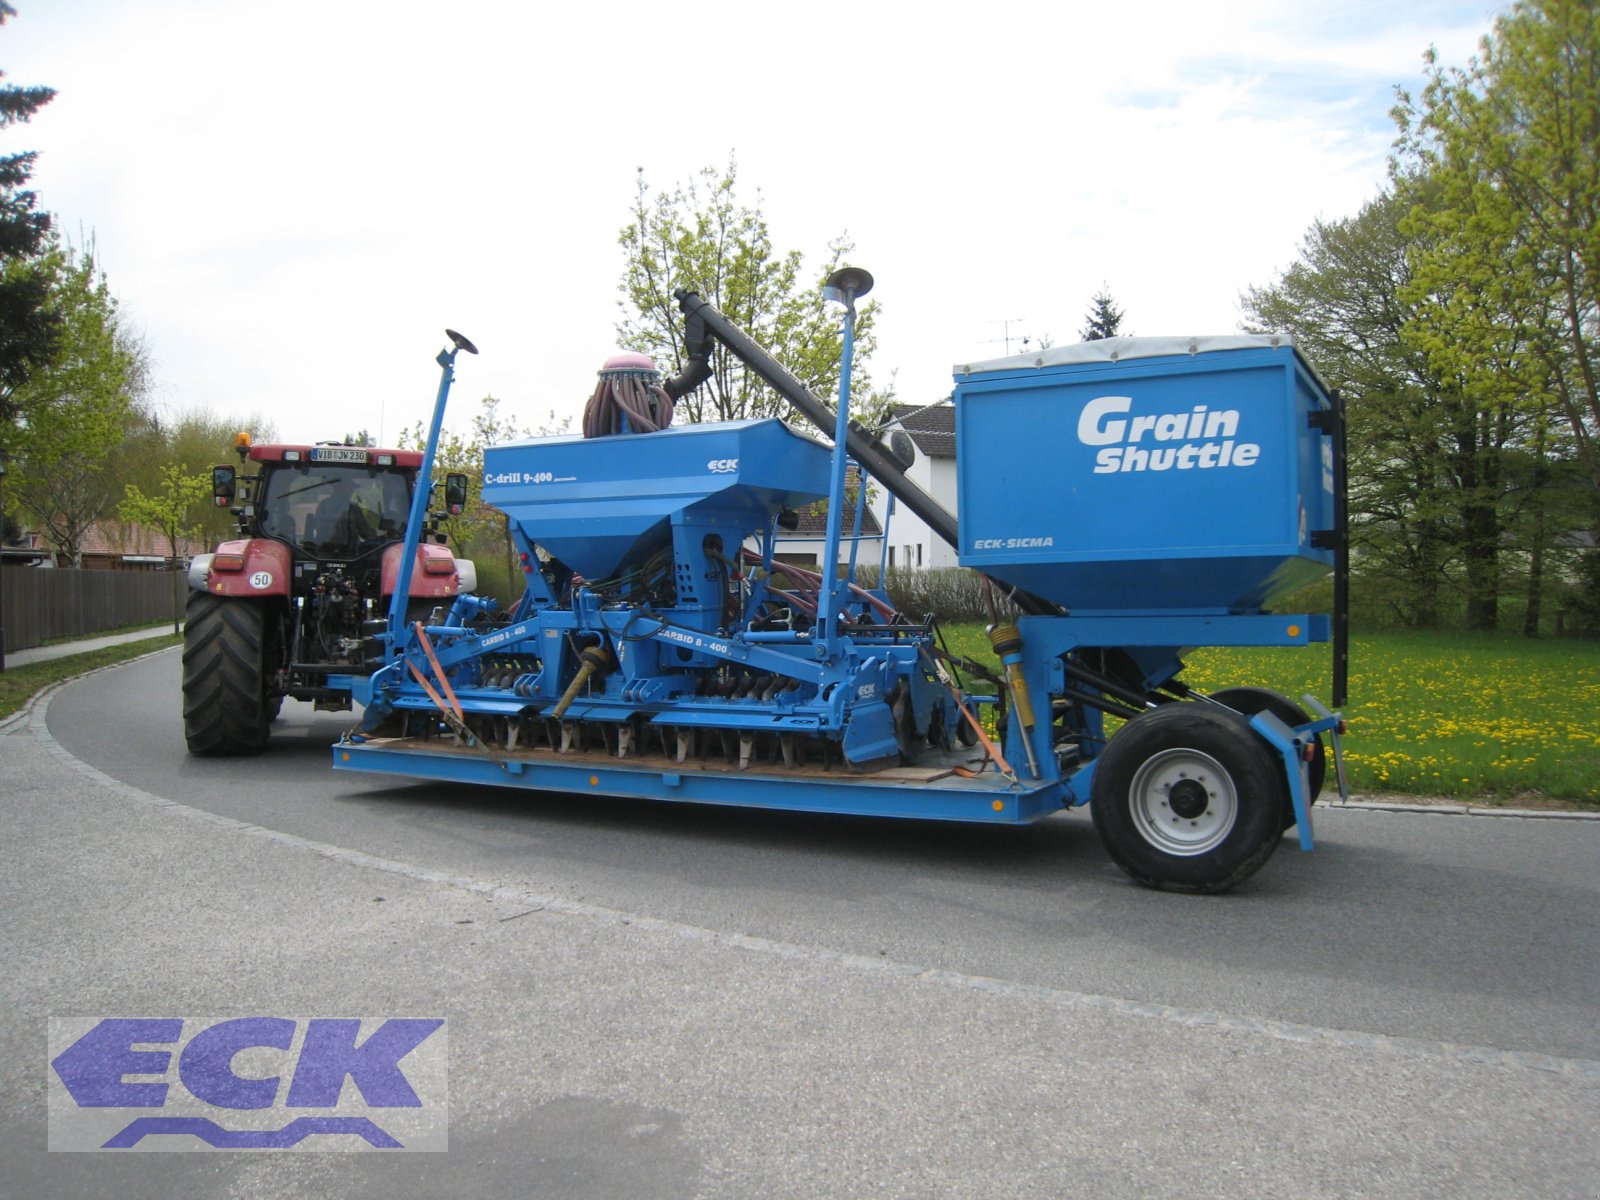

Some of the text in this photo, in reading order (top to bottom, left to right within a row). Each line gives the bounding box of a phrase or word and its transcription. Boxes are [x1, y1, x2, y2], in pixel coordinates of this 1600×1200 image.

[1077, 396, 1239, 446] Grain
[318, 450, 365, 461] VIB JW 230
[707, 458, 739, 470] ECK
[485, 473, 520, 484] C-drill
[523, 472, 552, 484] 9-400
[254, 574, 269, 586] 50
[695, 638, 702, 647] 8
[709, 642, 728, 654] 400
